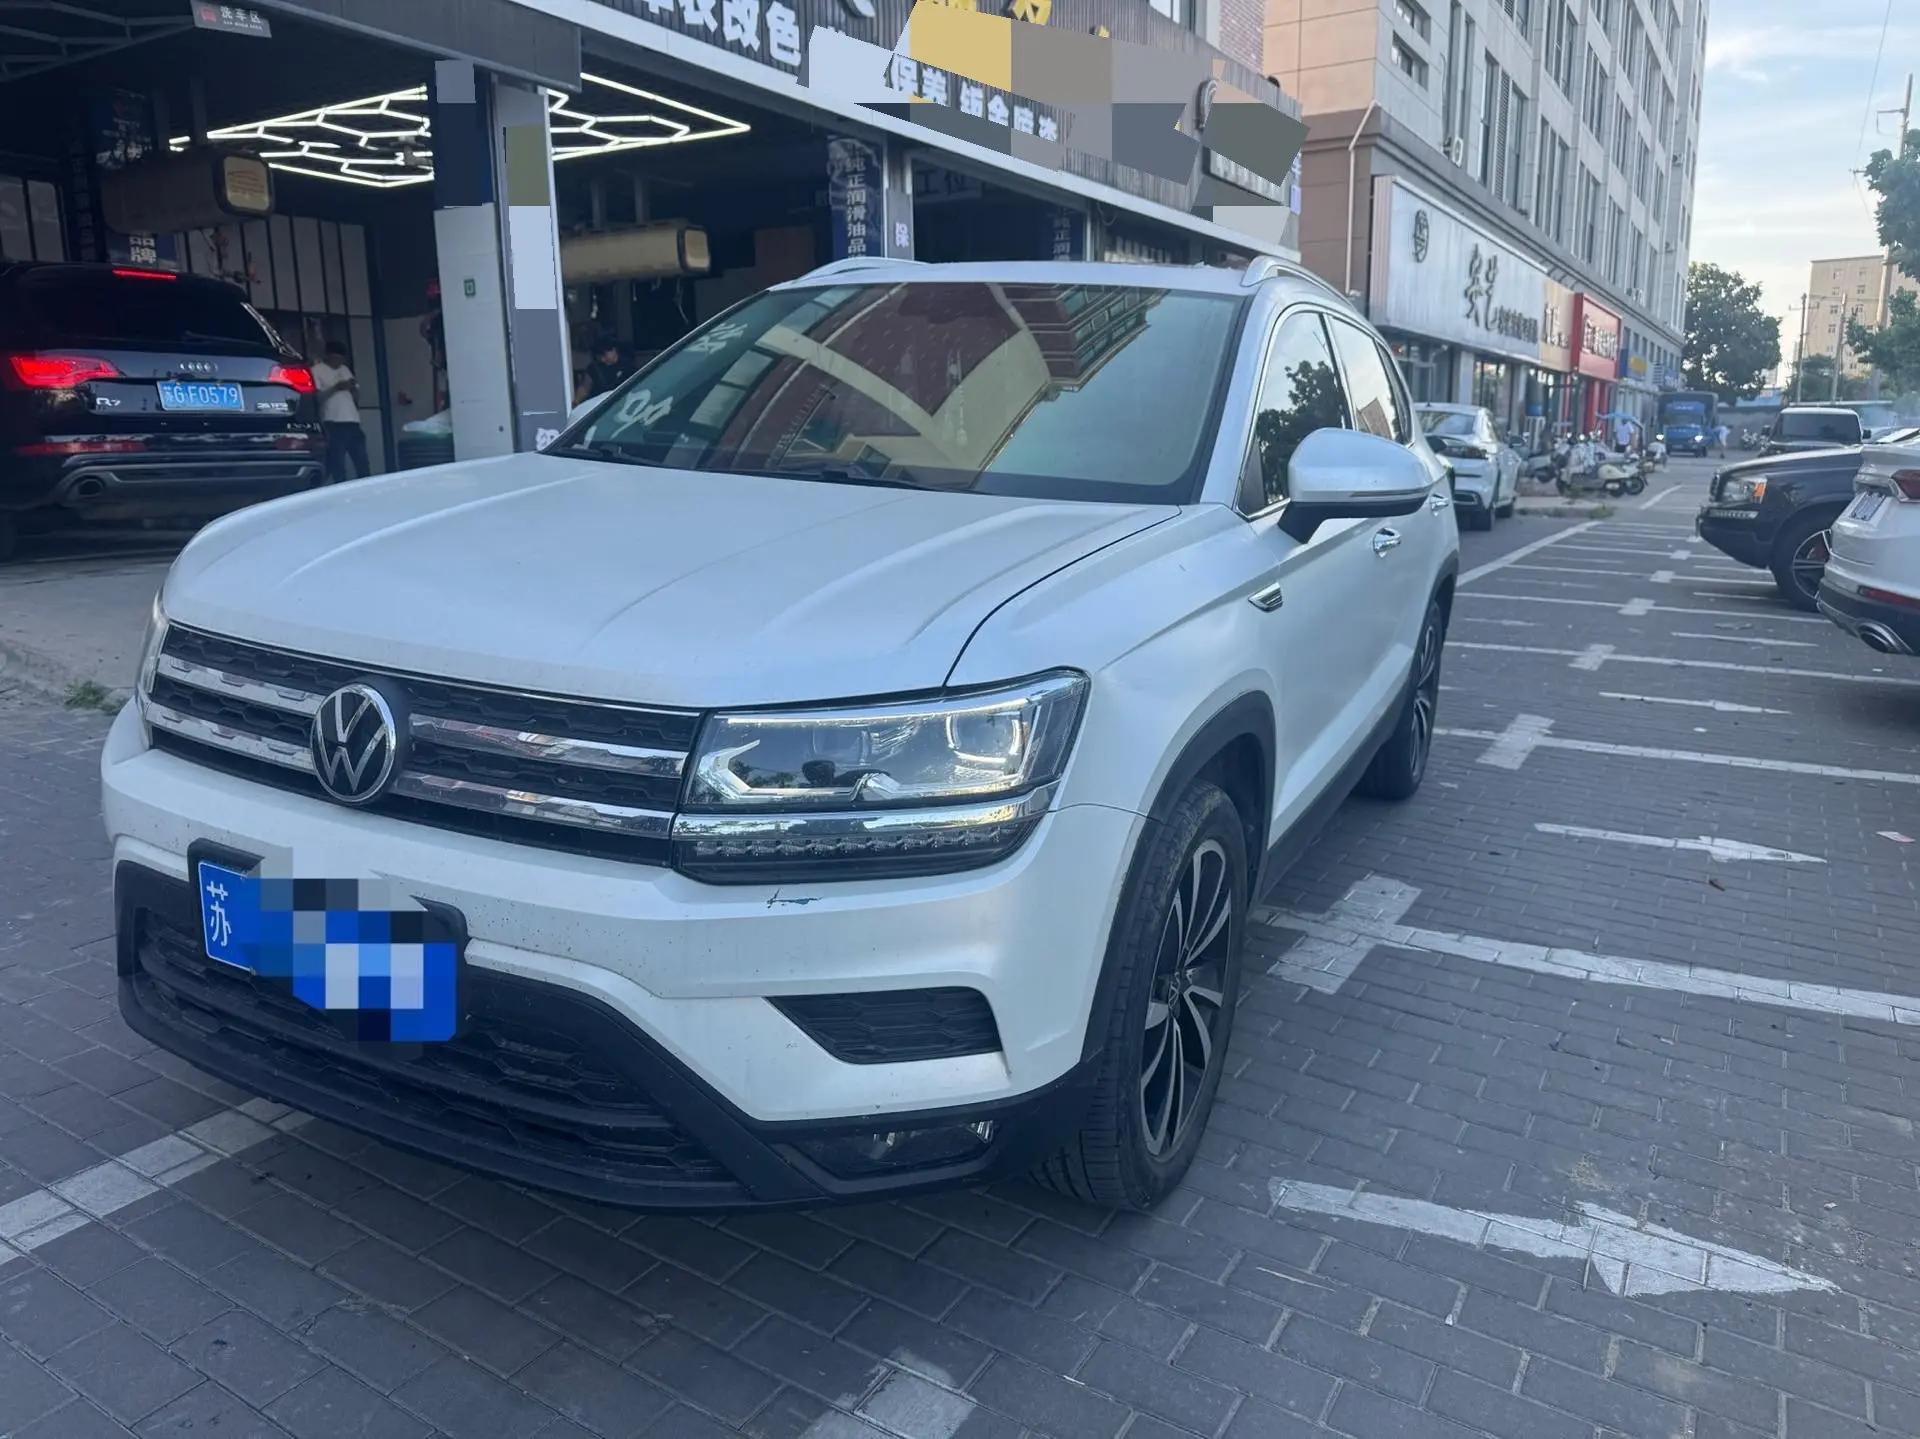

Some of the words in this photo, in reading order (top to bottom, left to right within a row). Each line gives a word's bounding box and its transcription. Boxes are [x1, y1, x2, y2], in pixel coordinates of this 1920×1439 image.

[846, 157, 867, 259] 纯正润滑油品
[206, 879, 232, 947] 苏
